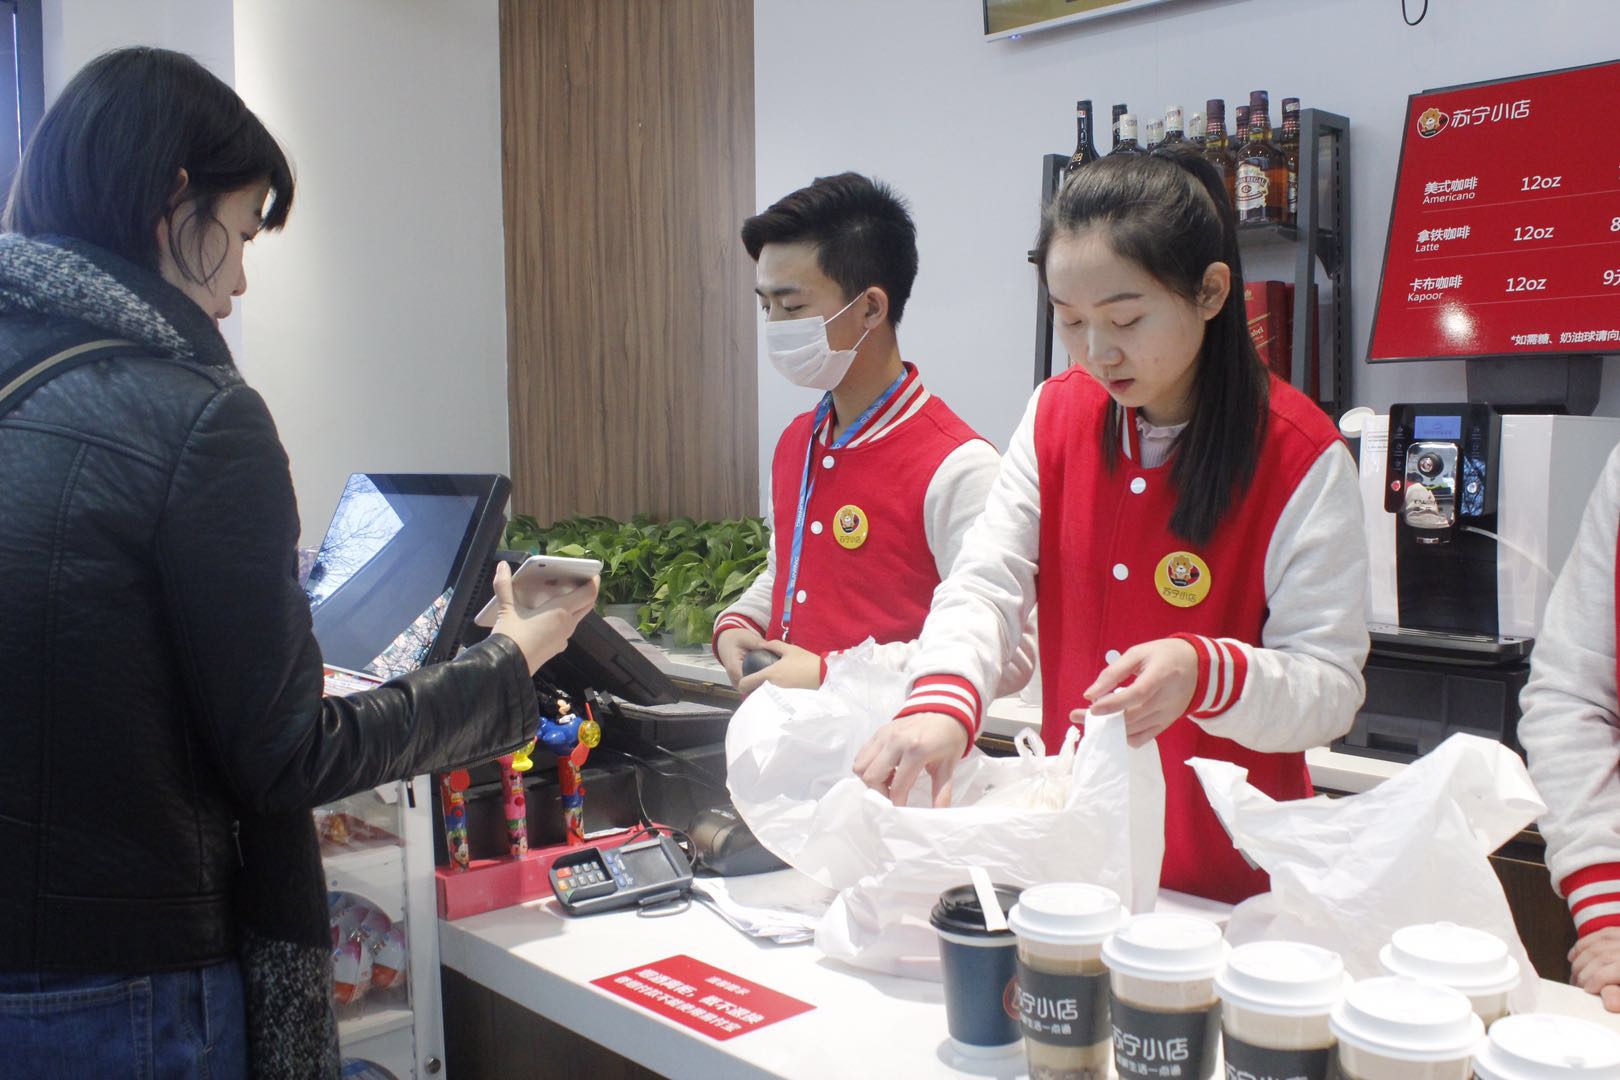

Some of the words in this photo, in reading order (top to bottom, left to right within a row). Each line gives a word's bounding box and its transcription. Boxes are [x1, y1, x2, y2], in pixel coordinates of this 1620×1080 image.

[1451, 99, 1531, 128] 苏宁小店
[1424, 176, 1478, 195] 美式咖啡
[1521, 175, 1562, 191] 12oz
[1422, 192, 1476, 204] Americano
[1416, 225, 1471, 243] 拿铁咖啡
[1513, 226, 1555, 241] 12oz
[1415, 242, 1439, 253] Latte
[1409, 275, 1464, 292] 卡布咖啡
[1505, 277, 1547, 292] 12oz
[1407, 292, 1443, 303] Kapoor
